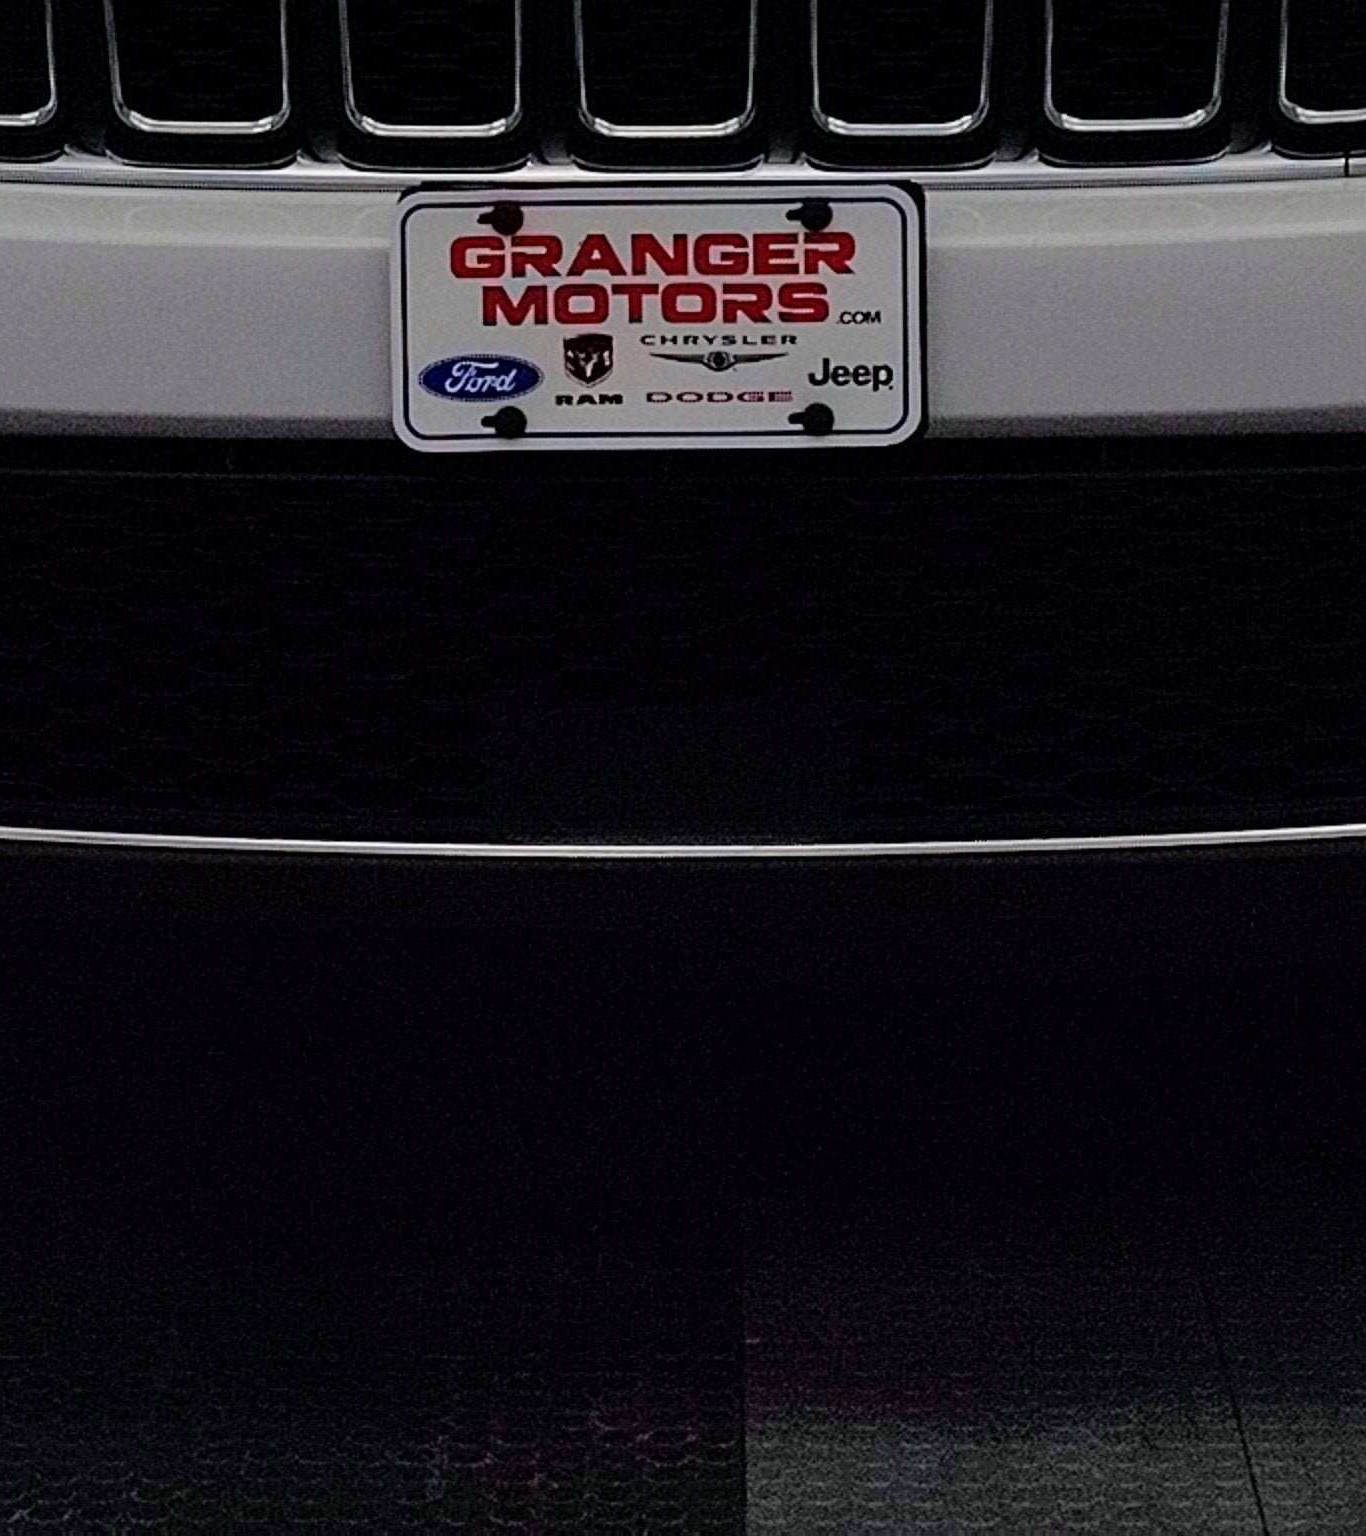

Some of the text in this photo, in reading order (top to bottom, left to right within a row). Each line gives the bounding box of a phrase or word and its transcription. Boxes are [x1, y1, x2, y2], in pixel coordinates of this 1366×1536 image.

[450, 231, 856, 279] GRANGER
[482, 282, 829, 326] MOTORS
[640, 334, 798, 345] CHRYSLER
[444, 361, 518, 393] Ford
[808, 358, 892, 391] Jeep
[555, 394, 623, 405] RAM
[646, 391, 793, 403] DODGE
